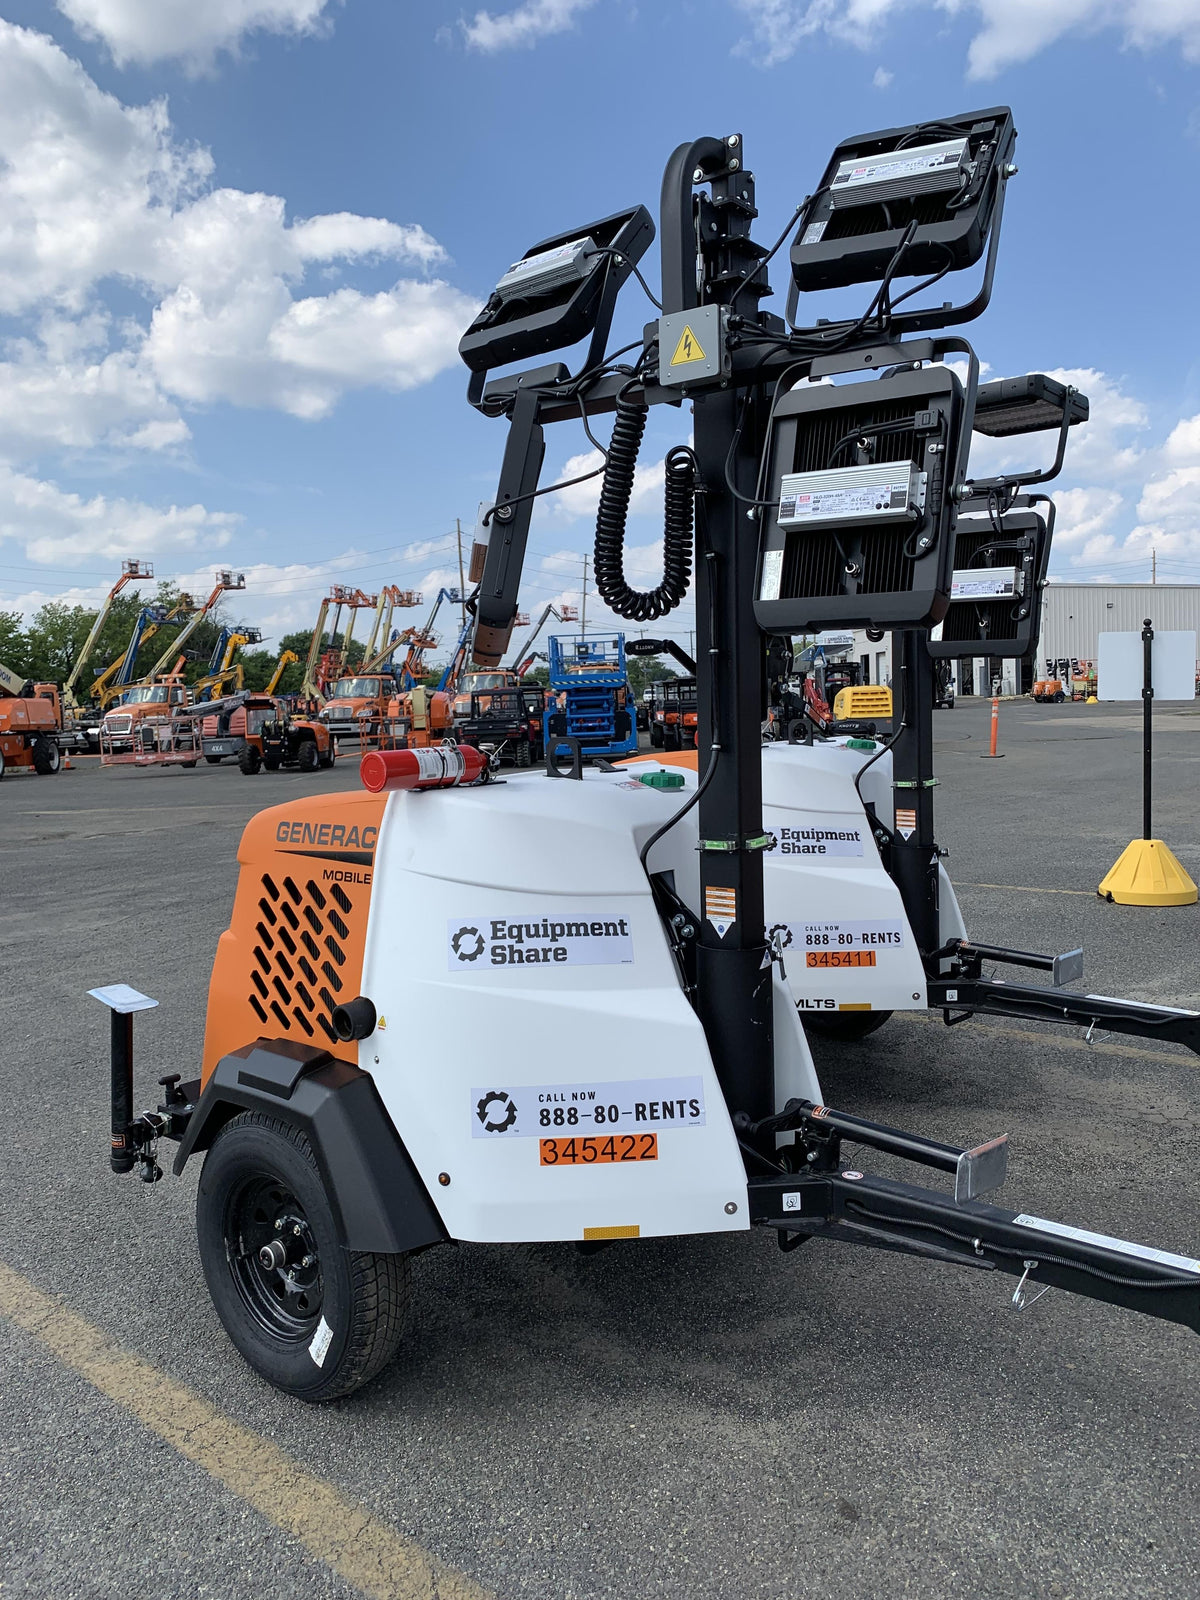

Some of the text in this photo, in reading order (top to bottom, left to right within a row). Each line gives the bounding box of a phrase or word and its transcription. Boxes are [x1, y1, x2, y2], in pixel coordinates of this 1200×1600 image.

[276, 821, 376, 849] GENERAC
[780, 827, 861, 845] Equipment
[781, 842, 827, 856] Share
[322, 869, 372, 884] MOBILE
[490, 918, 629, 944] Equipment
[491, 945, 567, 965] Share
[807, 951, 874, 968] 345411
[538, 1091, 596, 1103] CALL NOW
[542, 1133, 656, 1164] 345422
